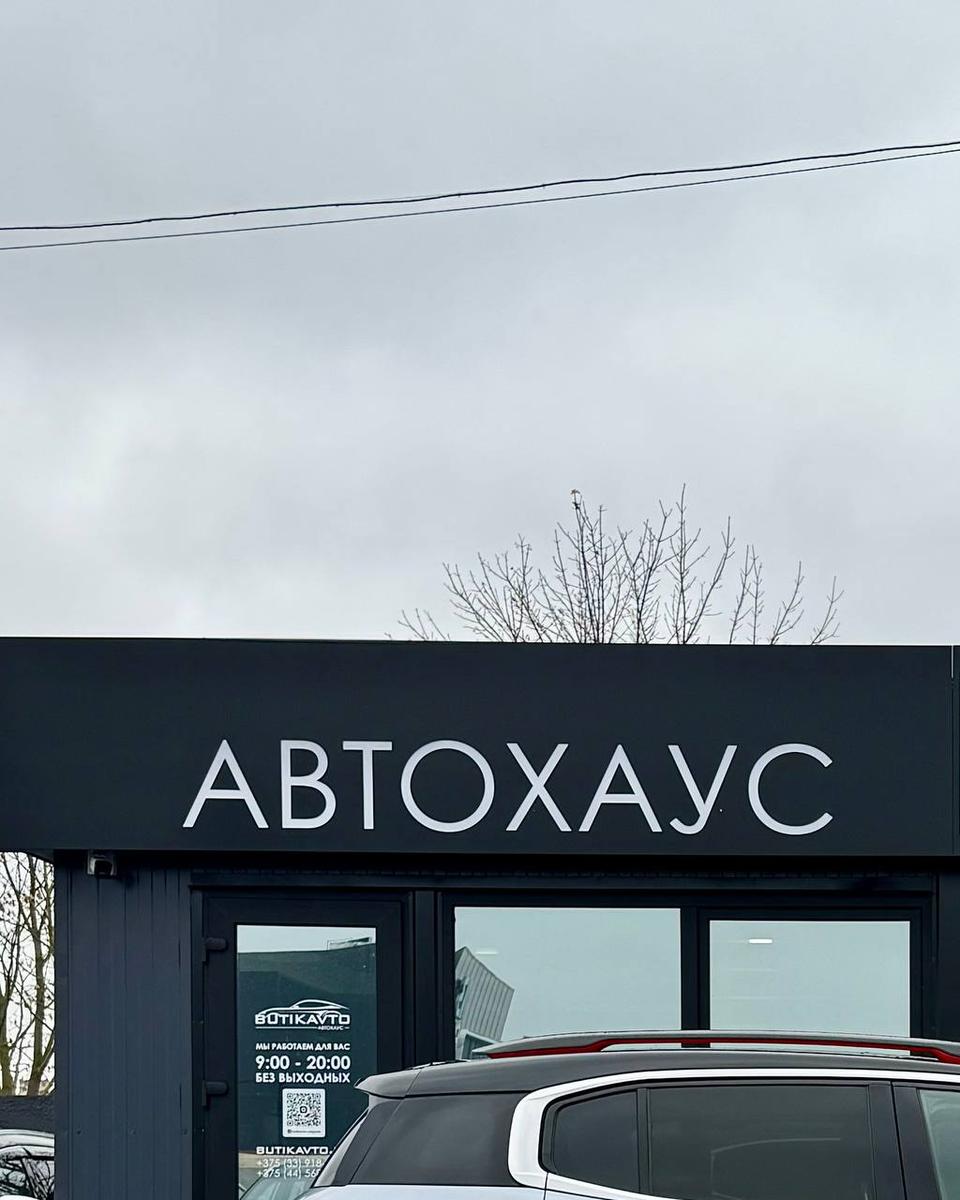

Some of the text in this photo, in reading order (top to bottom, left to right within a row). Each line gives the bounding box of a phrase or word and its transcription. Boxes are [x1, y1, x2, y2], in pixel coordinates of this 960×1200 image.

[183, 739, 833, 834] АВТОХАУС
[255, 1014, 350, 1025] BUTIKAVTO
[315, 1043, 332, 1051] ДЛЯ
[255, 1056, 290, 1070] 9:00
[306, 1055, 351, 1070] 20:00
[255, 1072, 350, 1084] БЕЗ ВЫХОДНЫХ
[256, 1146, 336, 1155] BUTIKAVTO.
[257, 1158, 281, 1168] +375
[283, 1158, 302, 1169] (33)
[257, 1168, 281, 1178] +375
[283, 1168, 302, 1179] (44)
